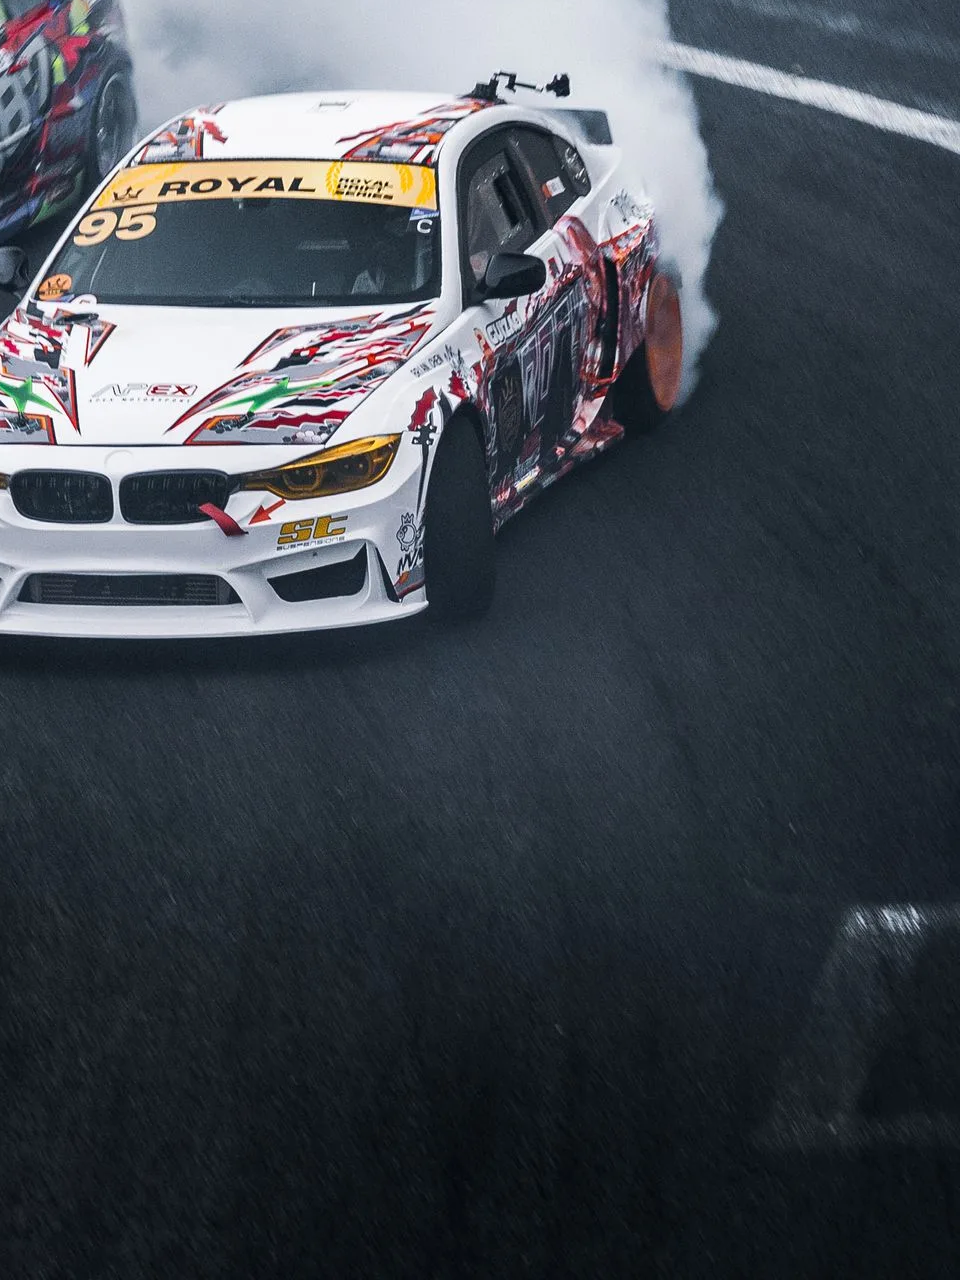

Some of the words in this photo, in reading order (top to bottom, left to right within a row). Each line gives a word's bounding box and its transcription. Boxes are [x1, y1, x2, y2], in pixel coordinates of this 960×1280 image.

[157, 176, 316, 197] ROYAL
[73, 204, 158, 247] 95
[416, 218, 433, 234] C
